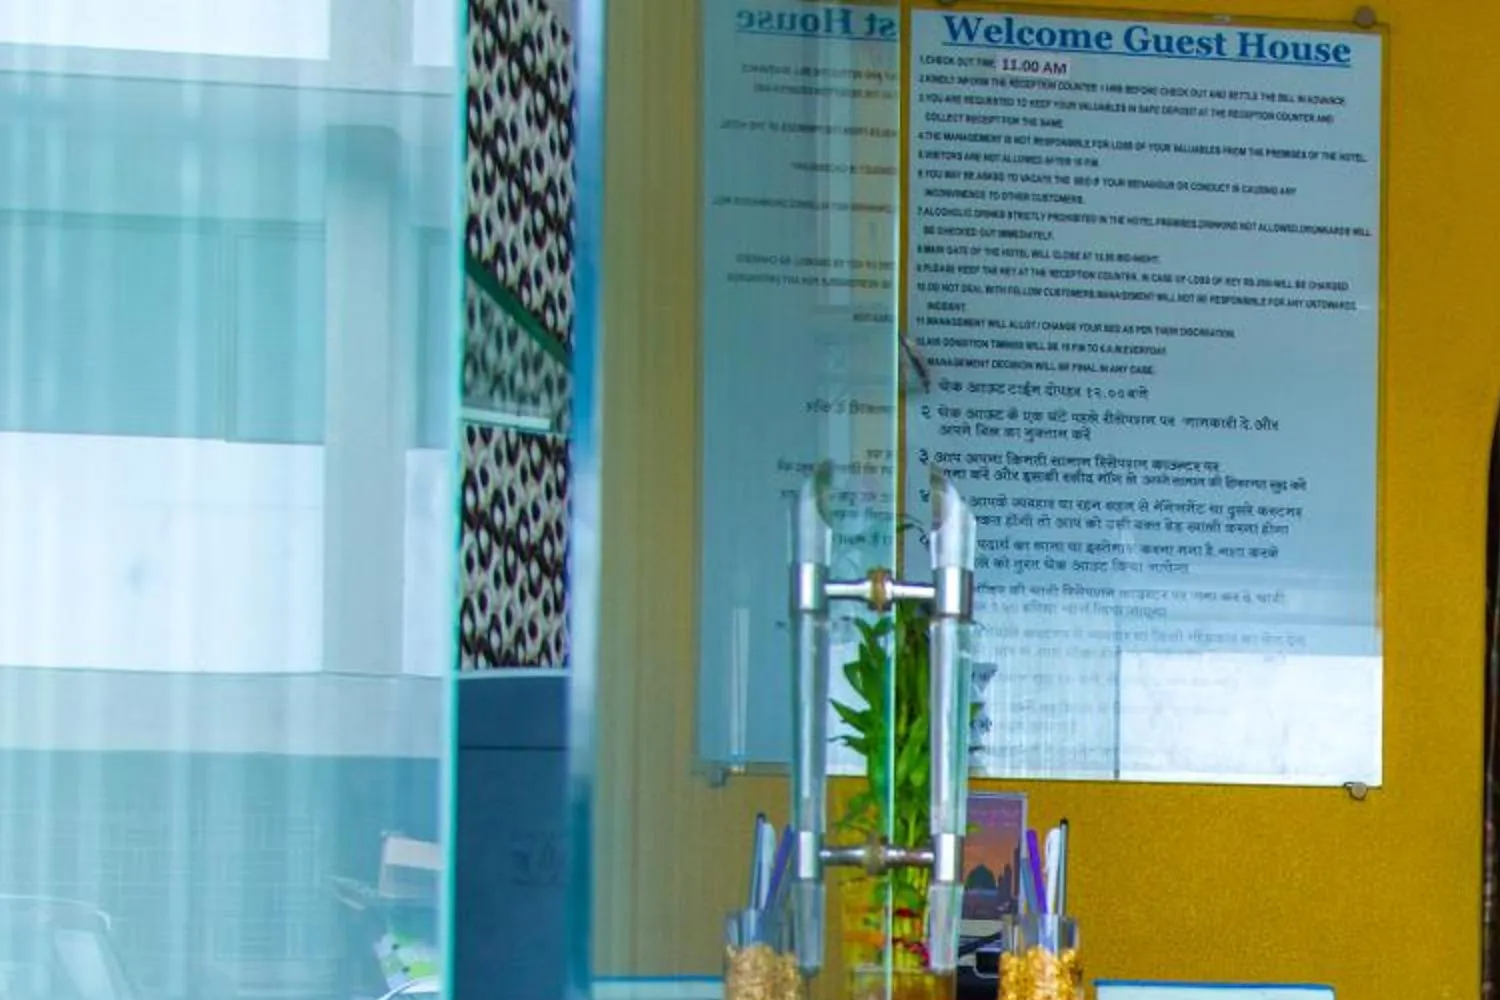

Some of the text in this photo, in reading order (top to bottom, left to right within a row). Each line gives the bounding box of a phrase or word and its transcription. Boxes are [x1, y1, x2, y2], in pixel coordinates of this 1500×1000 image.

[943, 15, 1350, 63] Welcome Guest House
[1000, 58, 1067, 74] 11.00 AM
[1209, 108, 1227, 118] THE
